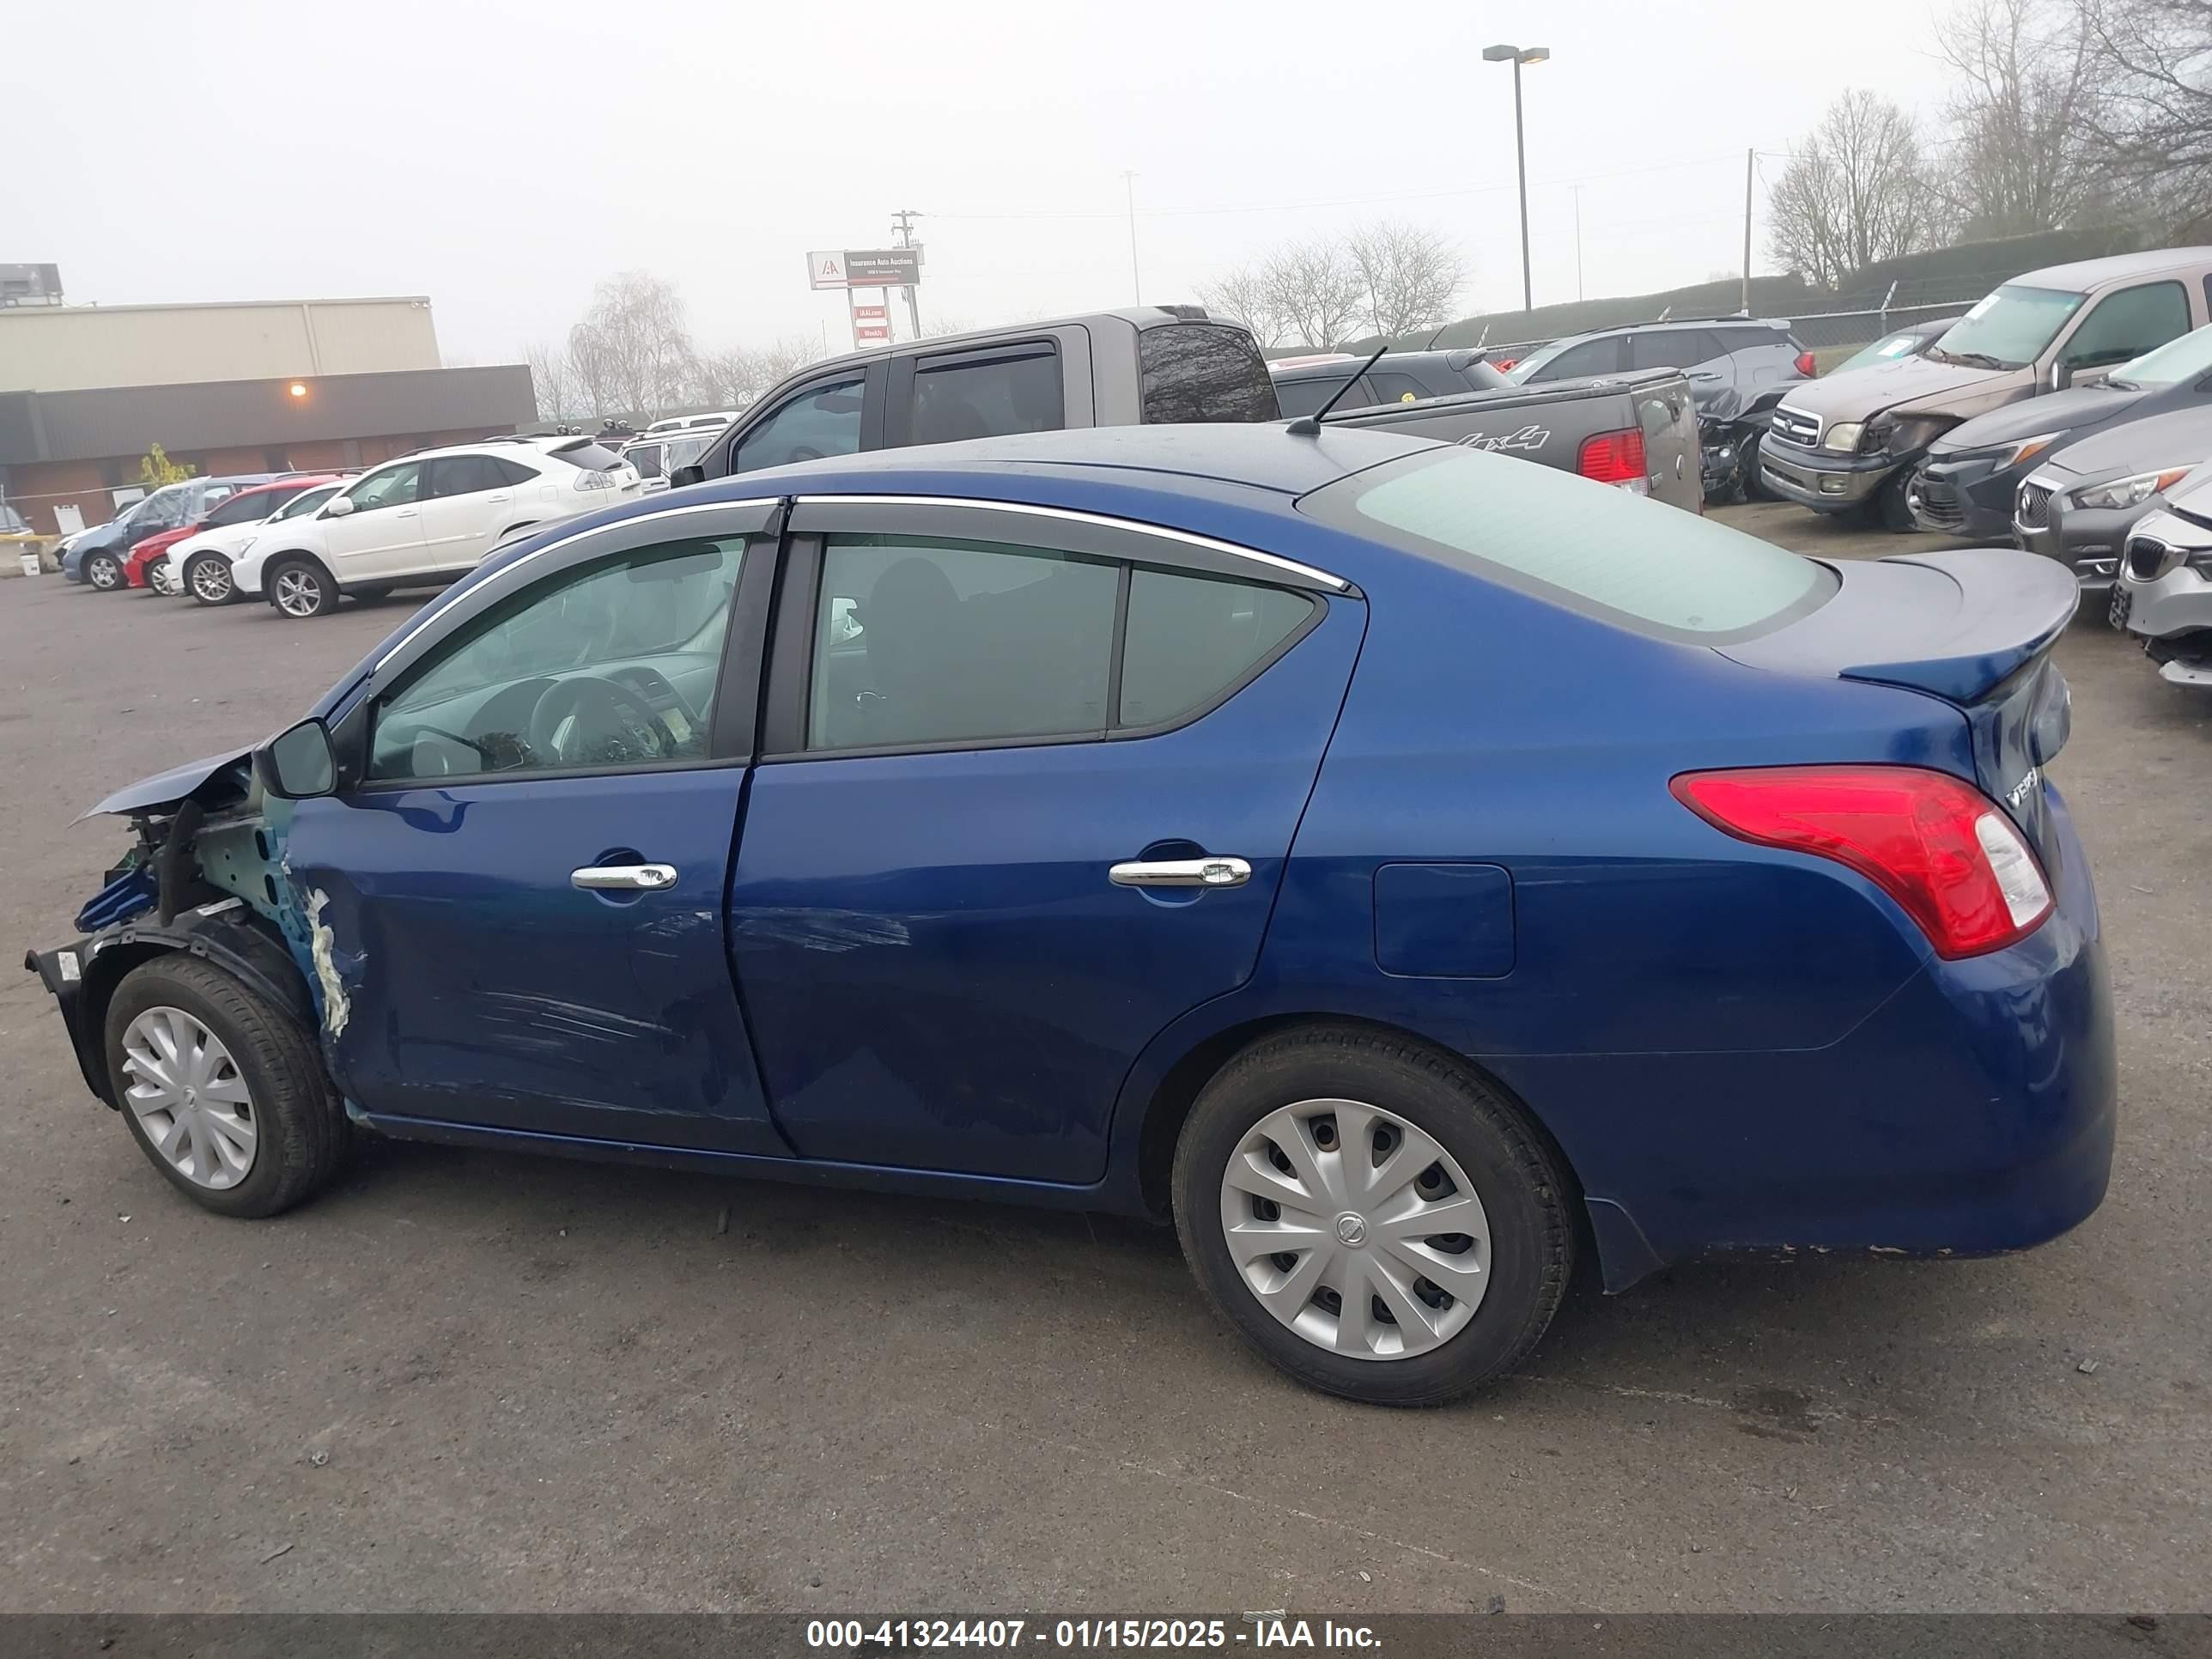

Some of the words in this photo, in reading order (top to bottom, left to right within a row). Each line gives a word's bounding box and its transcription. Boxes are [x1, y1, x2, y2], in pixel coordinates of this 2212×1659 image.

[849, 258, 876, 267] Insurance
[877, 258, 890, 266] Auto
[1455, 424, 1551, 451] 4x4
